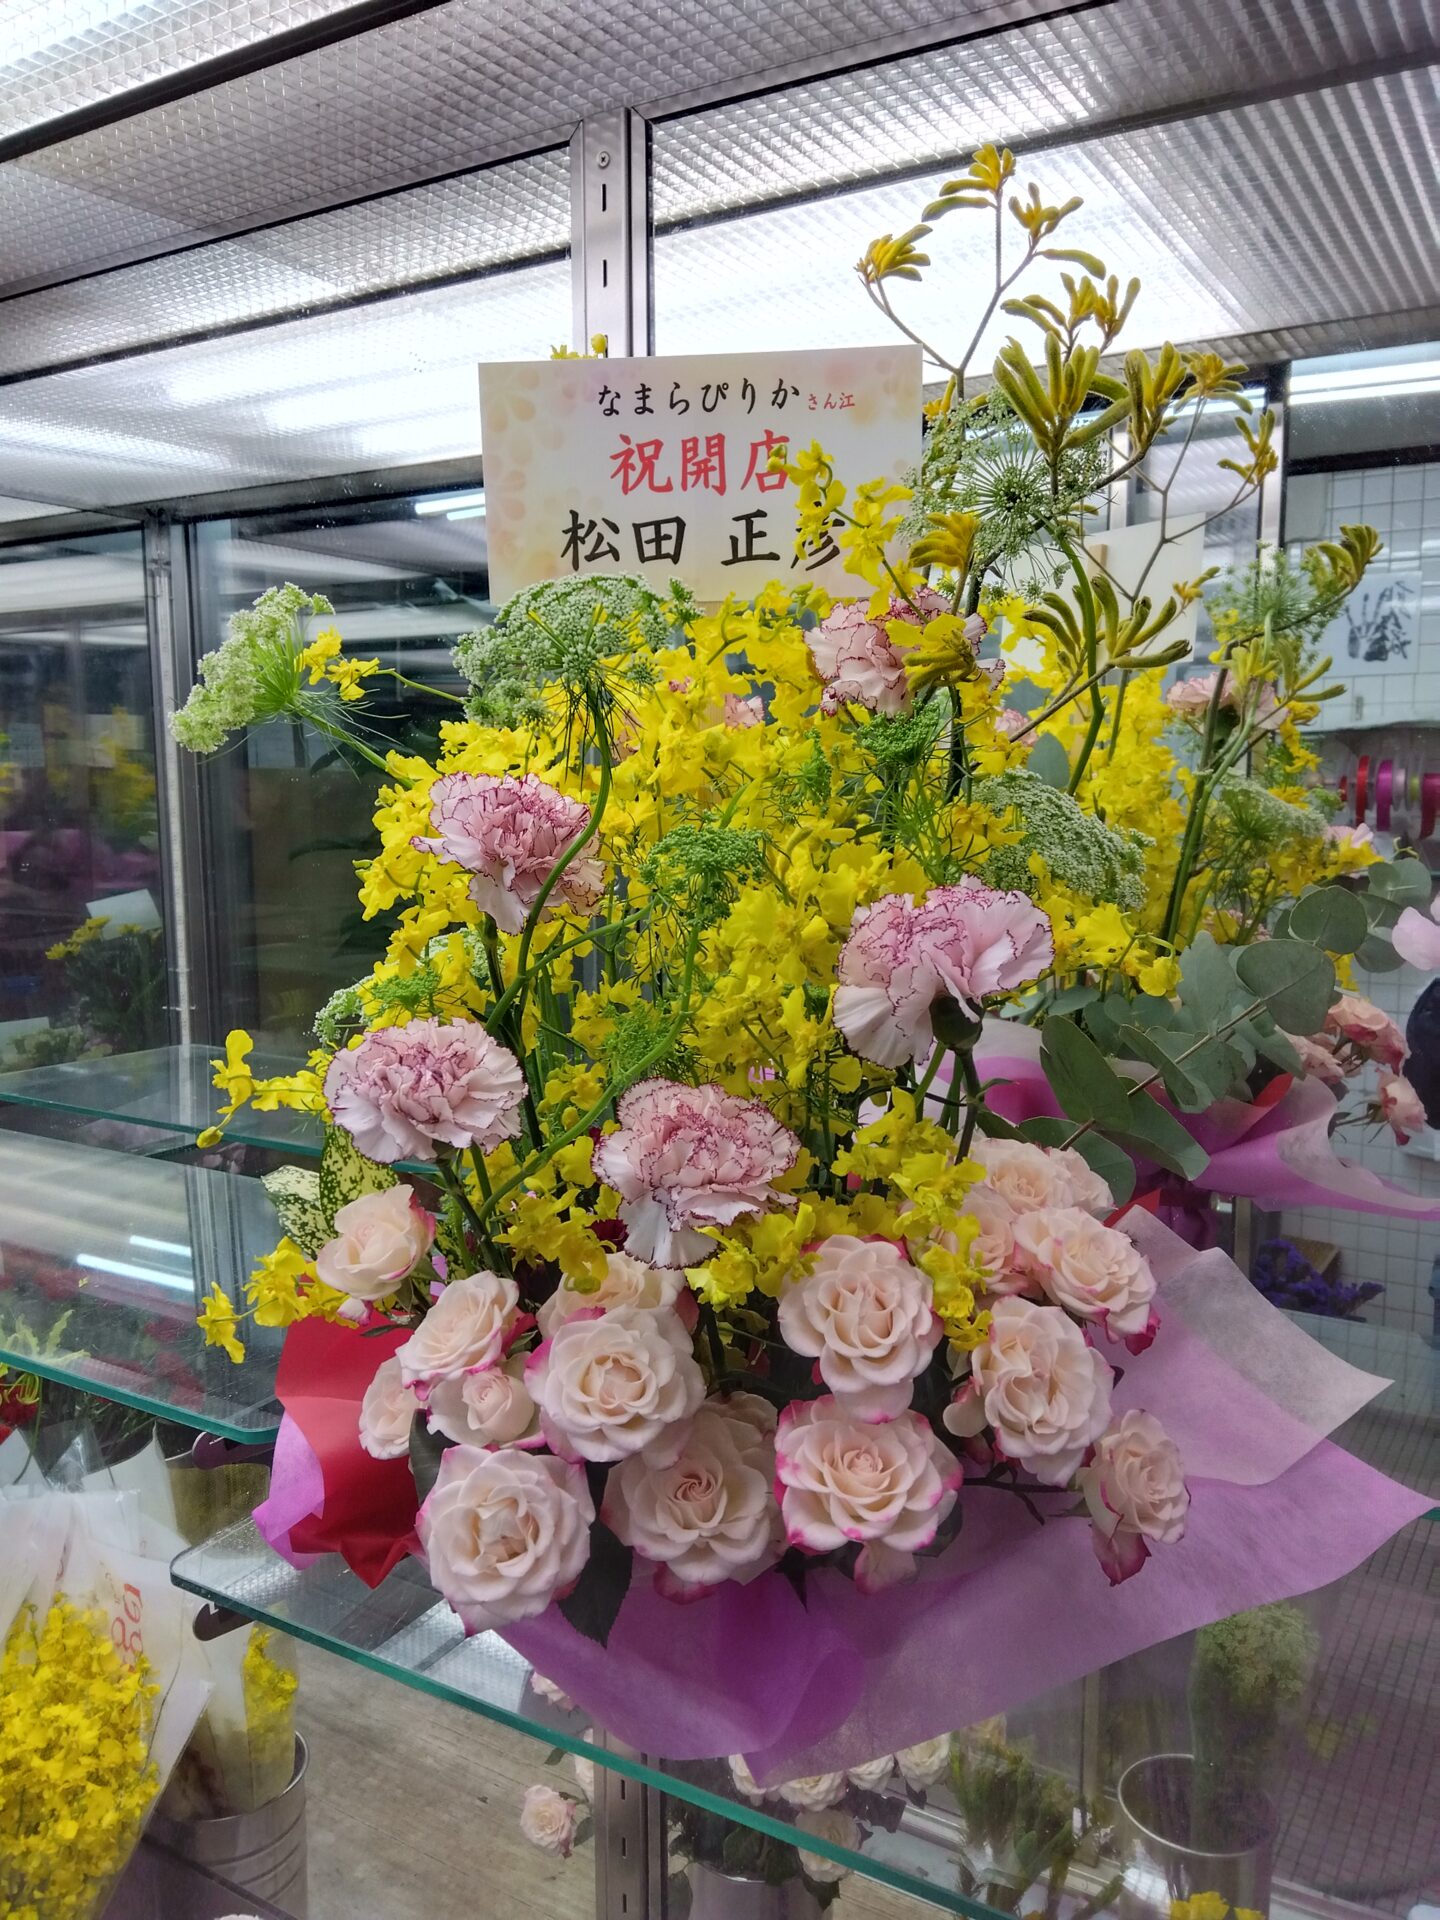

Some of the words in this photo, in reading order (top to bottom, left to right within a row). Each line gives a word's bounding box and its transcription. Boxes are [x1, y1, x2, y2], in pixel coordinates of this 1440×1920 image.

[598, 377, 801, 417] なまらぴりか
[807, 392, 857, 412] さん江
[610, 429, 792, 496] 祝開店
[560, 509, 687, 571] 松田
